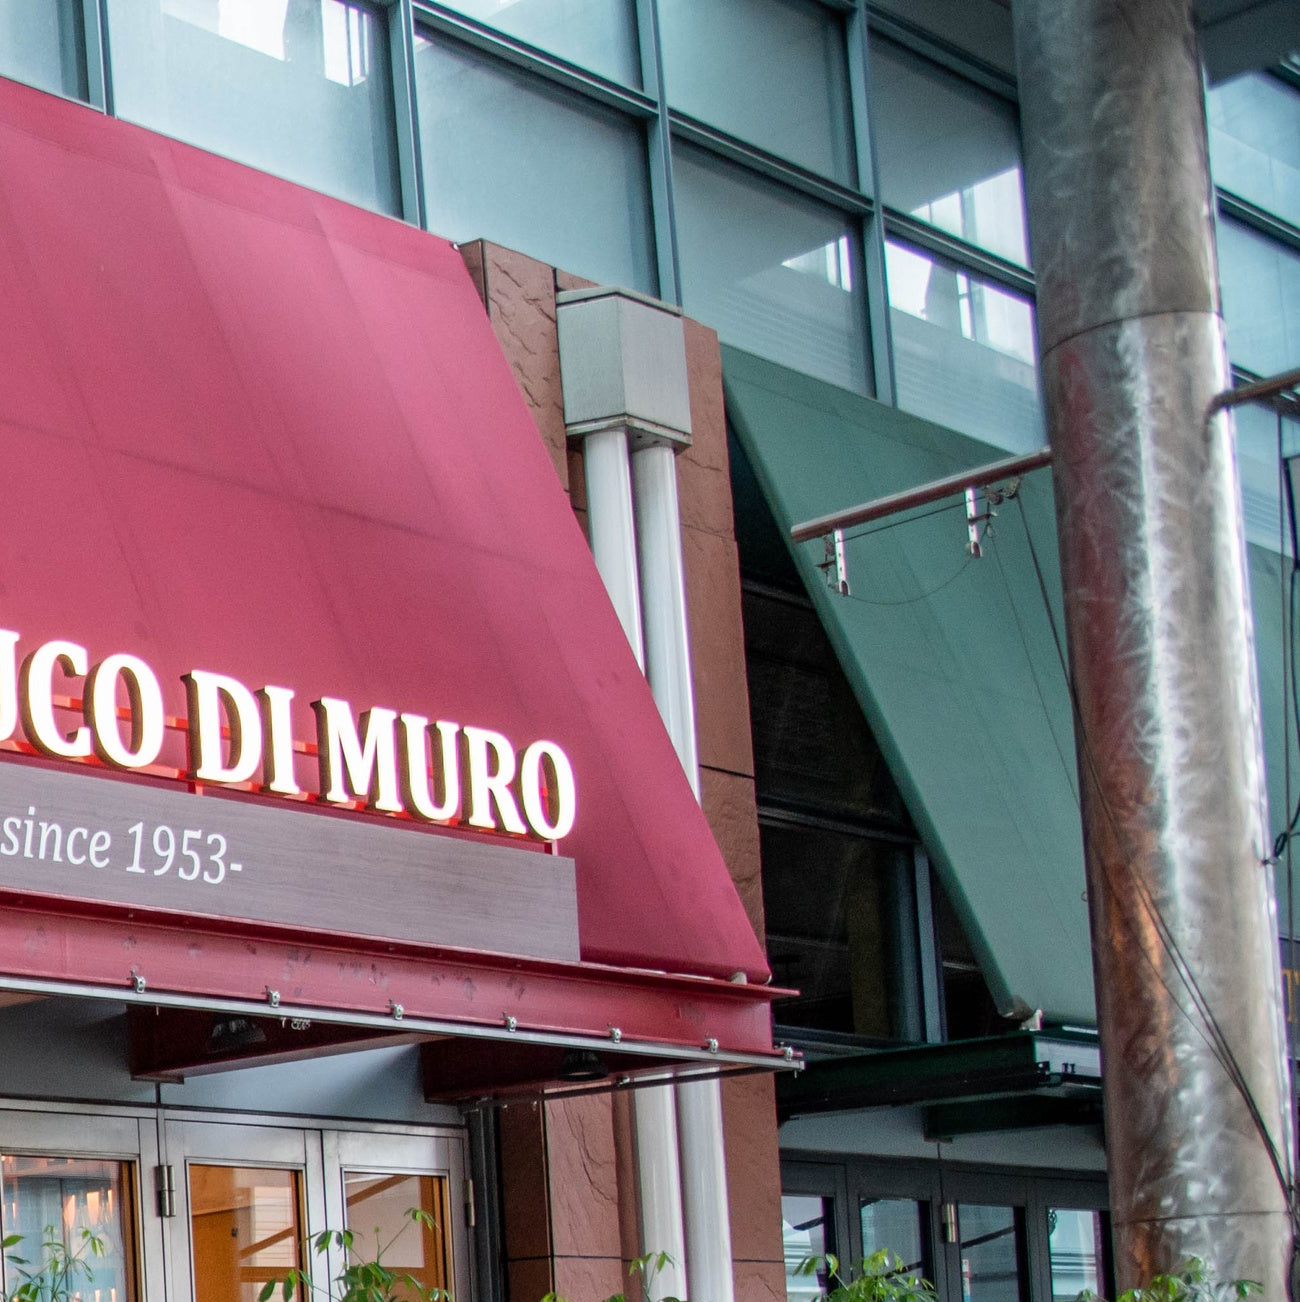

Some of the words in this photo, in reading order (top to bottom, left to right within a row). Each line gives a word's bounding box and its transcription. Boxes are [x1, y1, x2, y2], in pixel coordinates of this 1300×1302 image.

[188, 669, 300, 795] DI
[318, 697, 576, 840] MURO
[126, 821, 243, 885] 1953-
